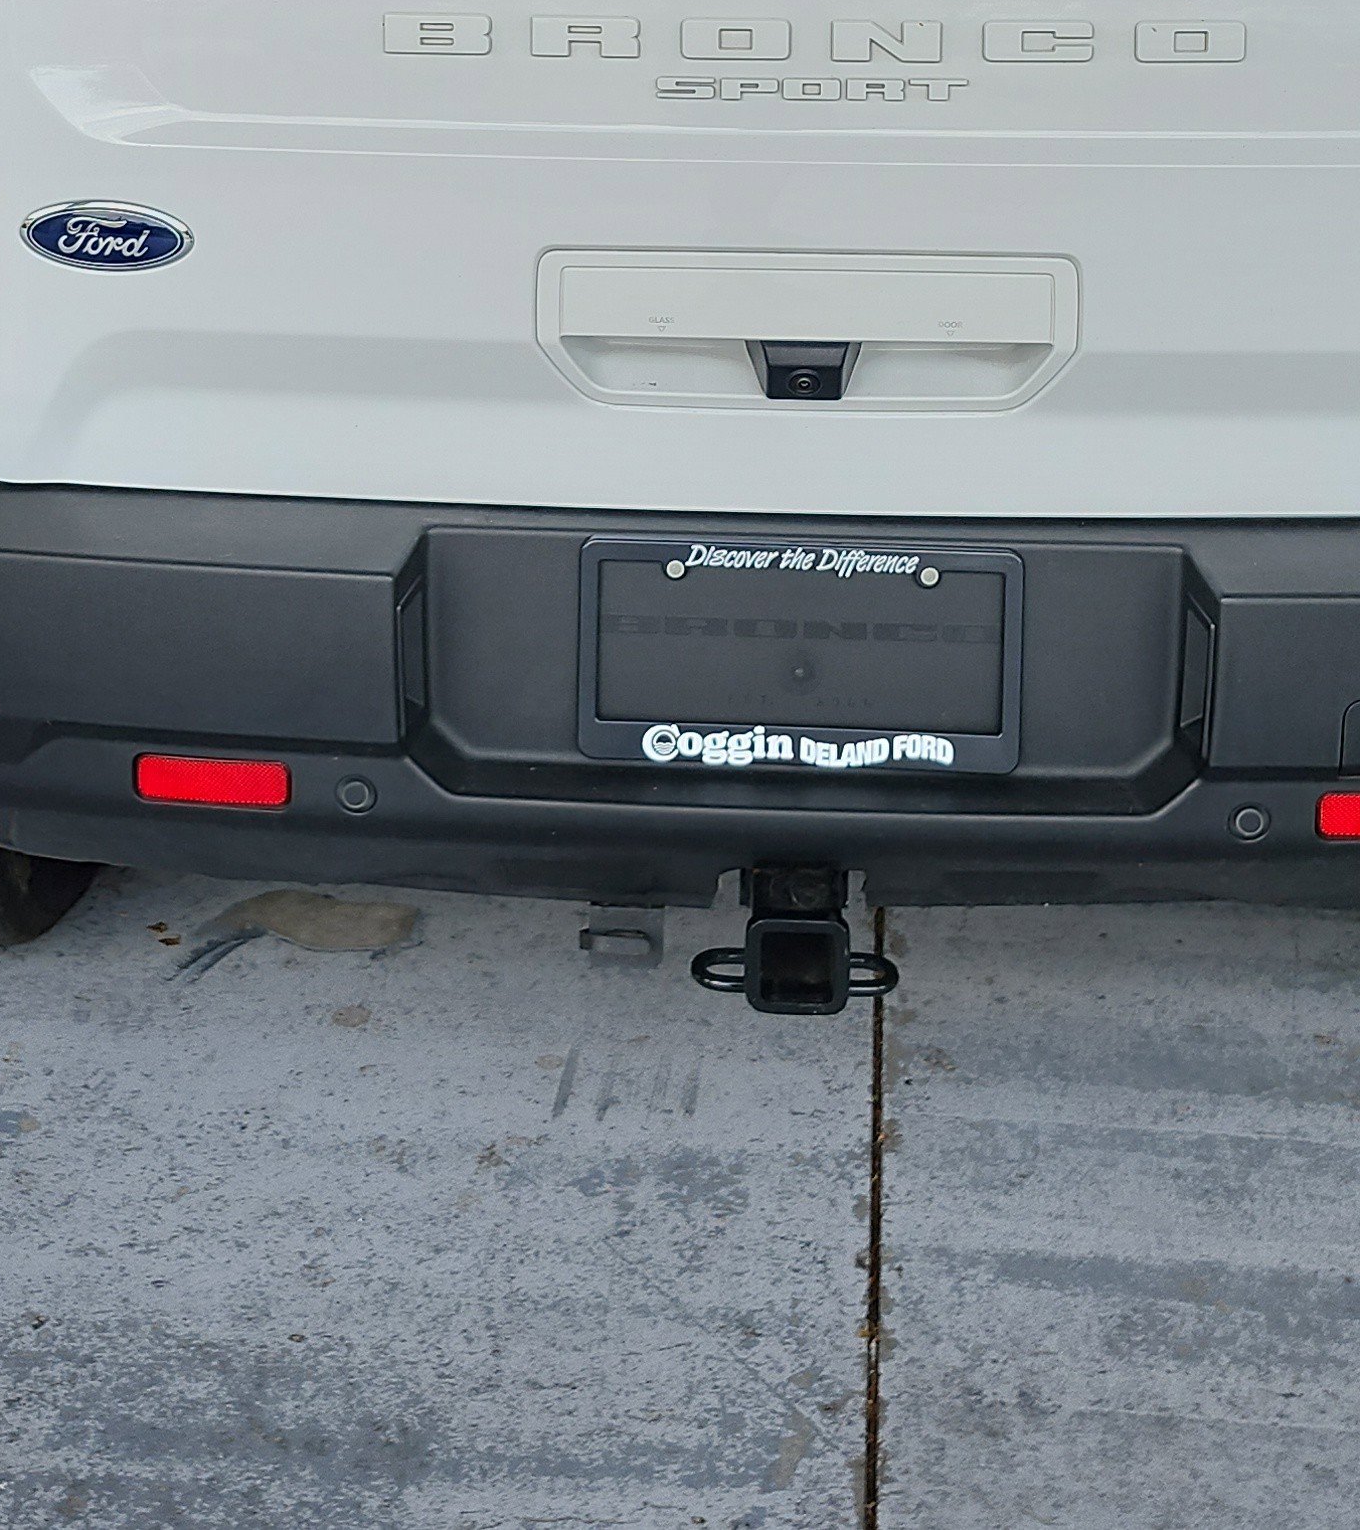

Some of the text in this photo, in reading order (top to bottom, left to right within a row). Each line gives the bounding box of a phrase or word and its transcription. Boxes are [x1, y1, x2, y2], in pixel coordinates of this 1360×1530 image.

[382, 12, 1248, 64] BRONCO
[654, 75, 970, 102] SPORT
[57, 215, 151, 258] Ford
[648, 315, 675, 324] GLASS
[685, 543, 920, 579] Discover the Difference
[599, 614, 1003, 645] BRONCO
[641, 723, 955, 768] Coggin DELAND FORD
